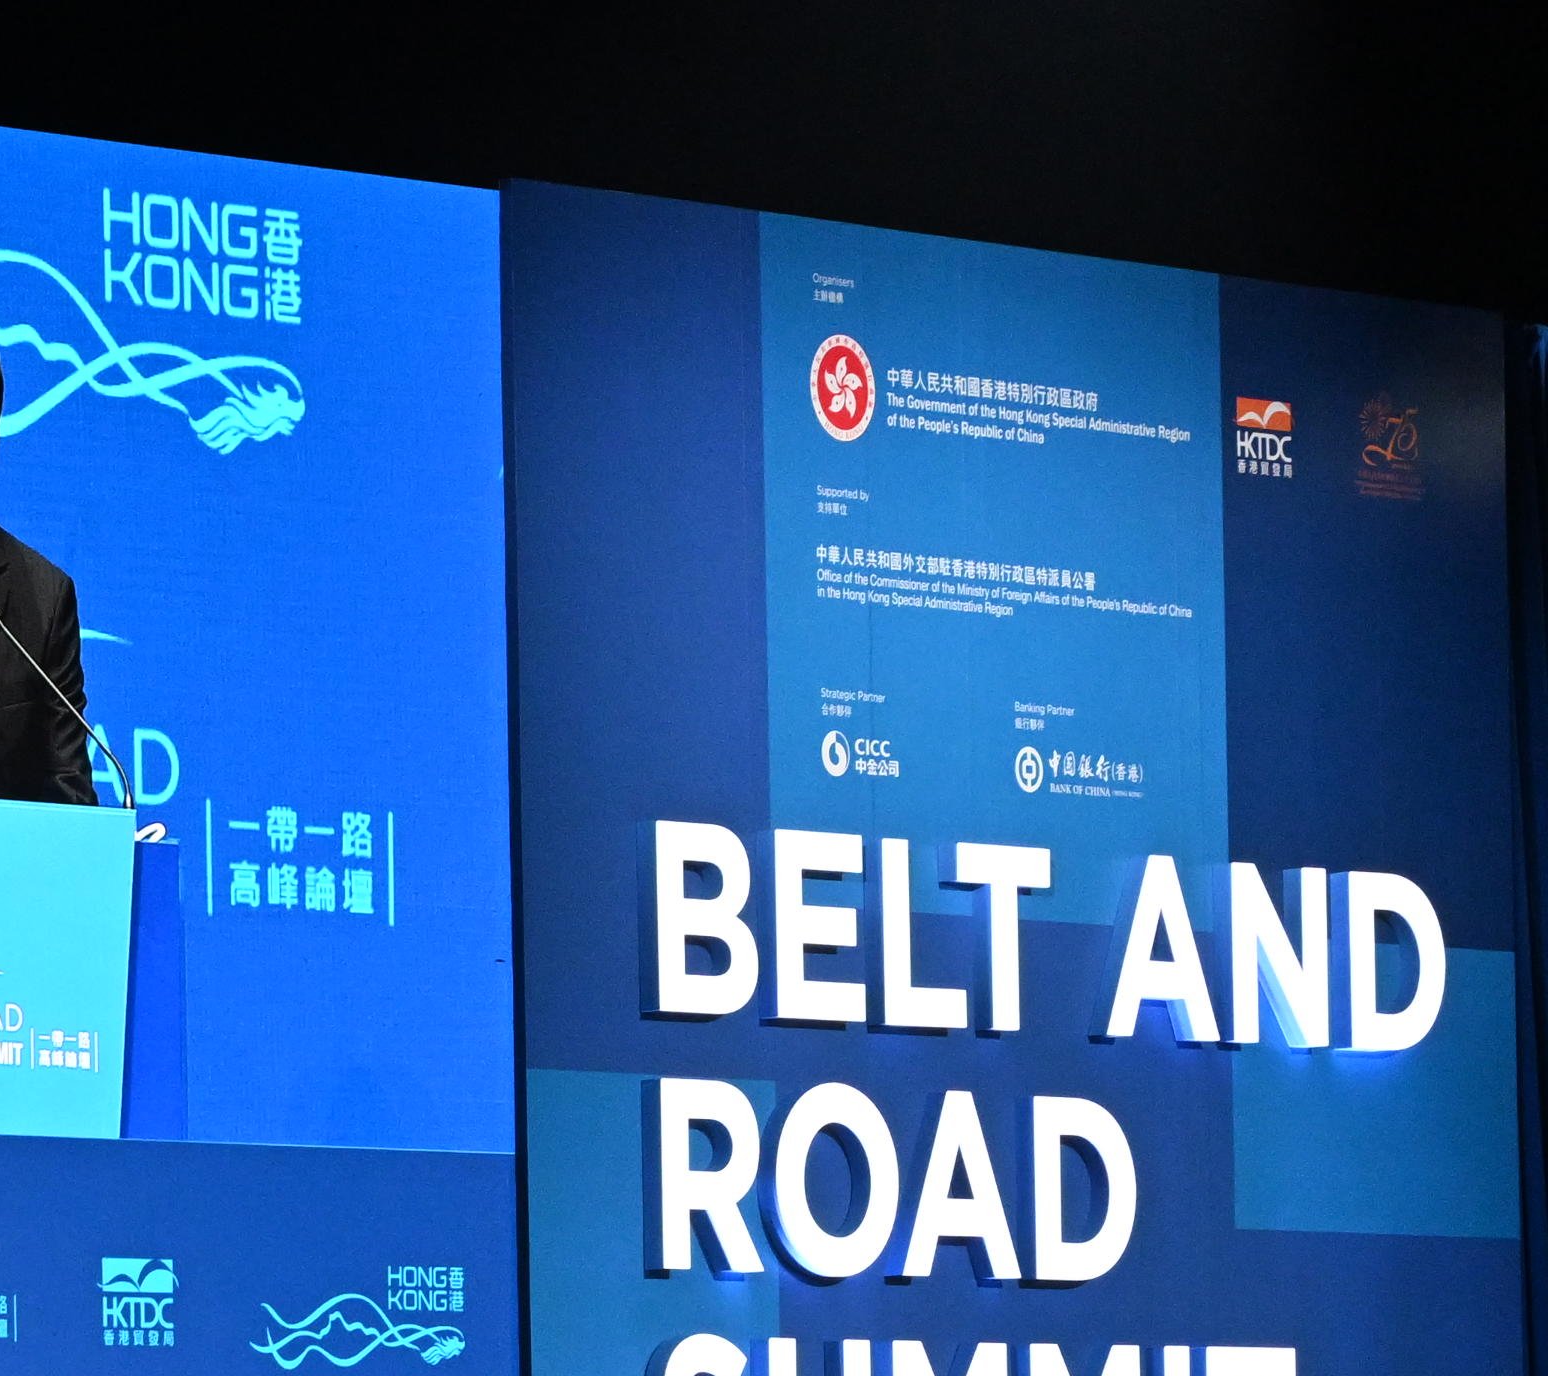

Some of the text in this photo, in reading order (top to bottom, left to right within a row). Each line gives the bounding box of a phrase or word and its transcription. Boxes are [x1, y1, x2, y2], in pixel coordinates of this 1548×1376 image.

[103, 188, 257, 258] HONG
[103, 254, 258, 318] KONG
[813, 273, 854, 288] Organisers
[888, 368, 1097, 411] 中華人民共和國香港特別行政區政府
[887, 393, 1190, 442] The Government of the Hong Kong Special Administrative Region
[887, 414, 1044, 444] of the People's Republic of China
[1237, 431, 1292, 463] HKTDC
[817, 485, 869, 501] Supported by
[817, 569, 1192, 617] Office of the Commissioner of the Ministry of Foreign Affairs of the People's Republic of China
[818, 587, 1013, 617] in the Hong Kong Special Administrative Region
[821, 688, 885, 702] Strategic Partner
[1015, 702, 1074, 716] Banking Partner
[855, 739, 890, 757] CICC
[856, 759, 899, 777] 中金公司
[1050, 783, 1071, 793] BANK
[1073, 785, 1083, 794] OF
[1085, 786, 1110, 796] CHINA
[229, 806, 372, 858] 一帶一路
[230, 861, 373, 913] 高峰論壇
[656, 821, 1445, 1051] BELT AND
[661, 1078, 1136, 1280] ROAD
[388, 1266, 447, 1287] HONG
[388, 1290, 447, 1311] KONG
